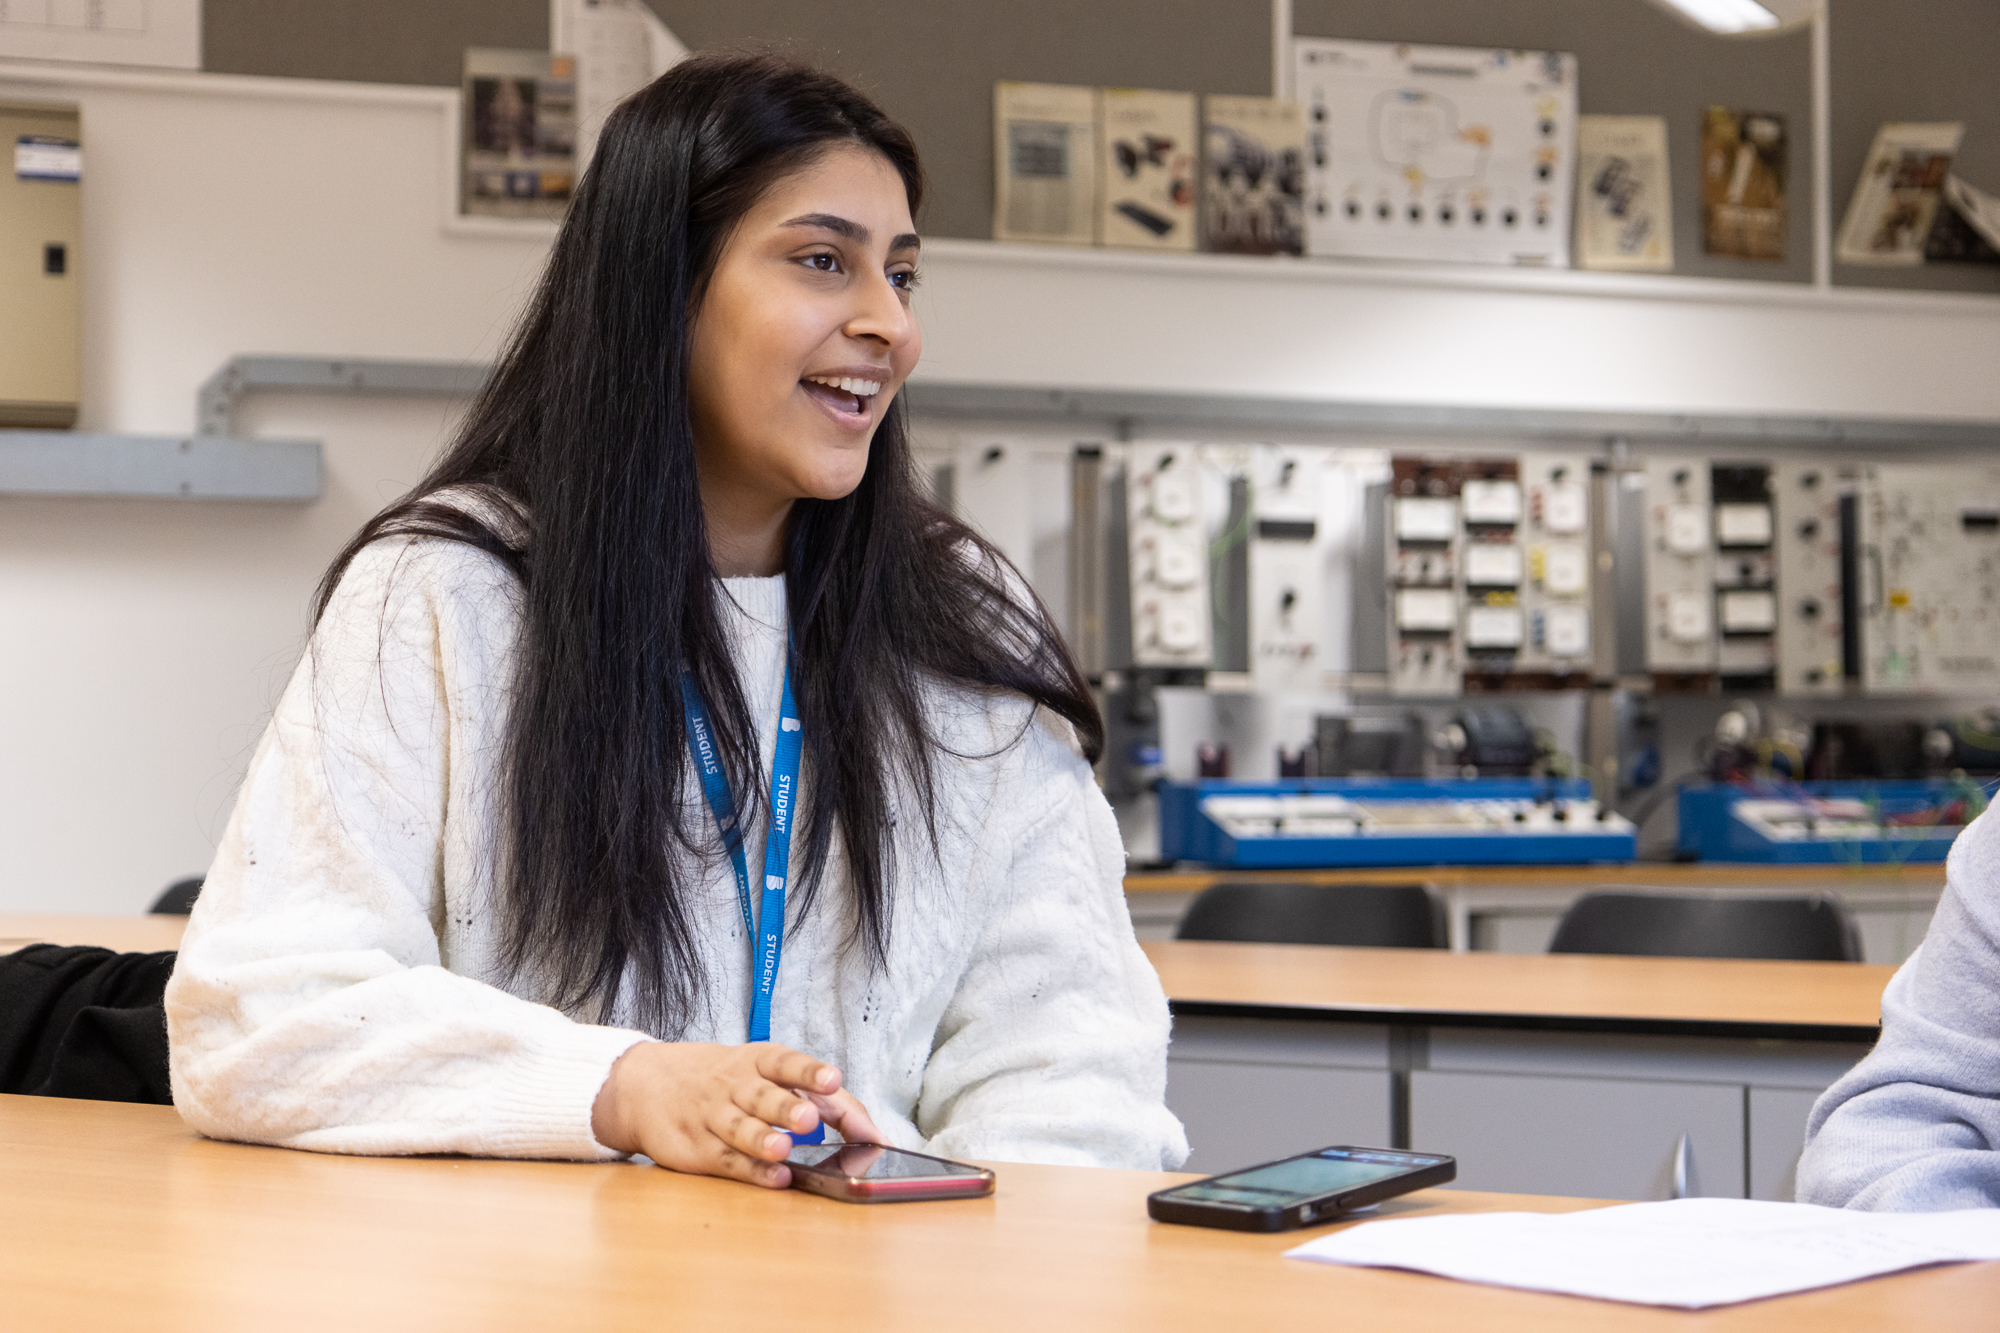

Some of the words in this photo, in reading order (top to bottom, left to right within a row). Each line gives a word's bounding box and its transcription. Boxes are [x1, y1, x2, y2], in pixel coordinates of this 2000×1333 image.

[692, 717, 718, 775] STUDENT
[775, 774, 790, 834] STUDENT
[762, 934, 777, 994] STUDENT
